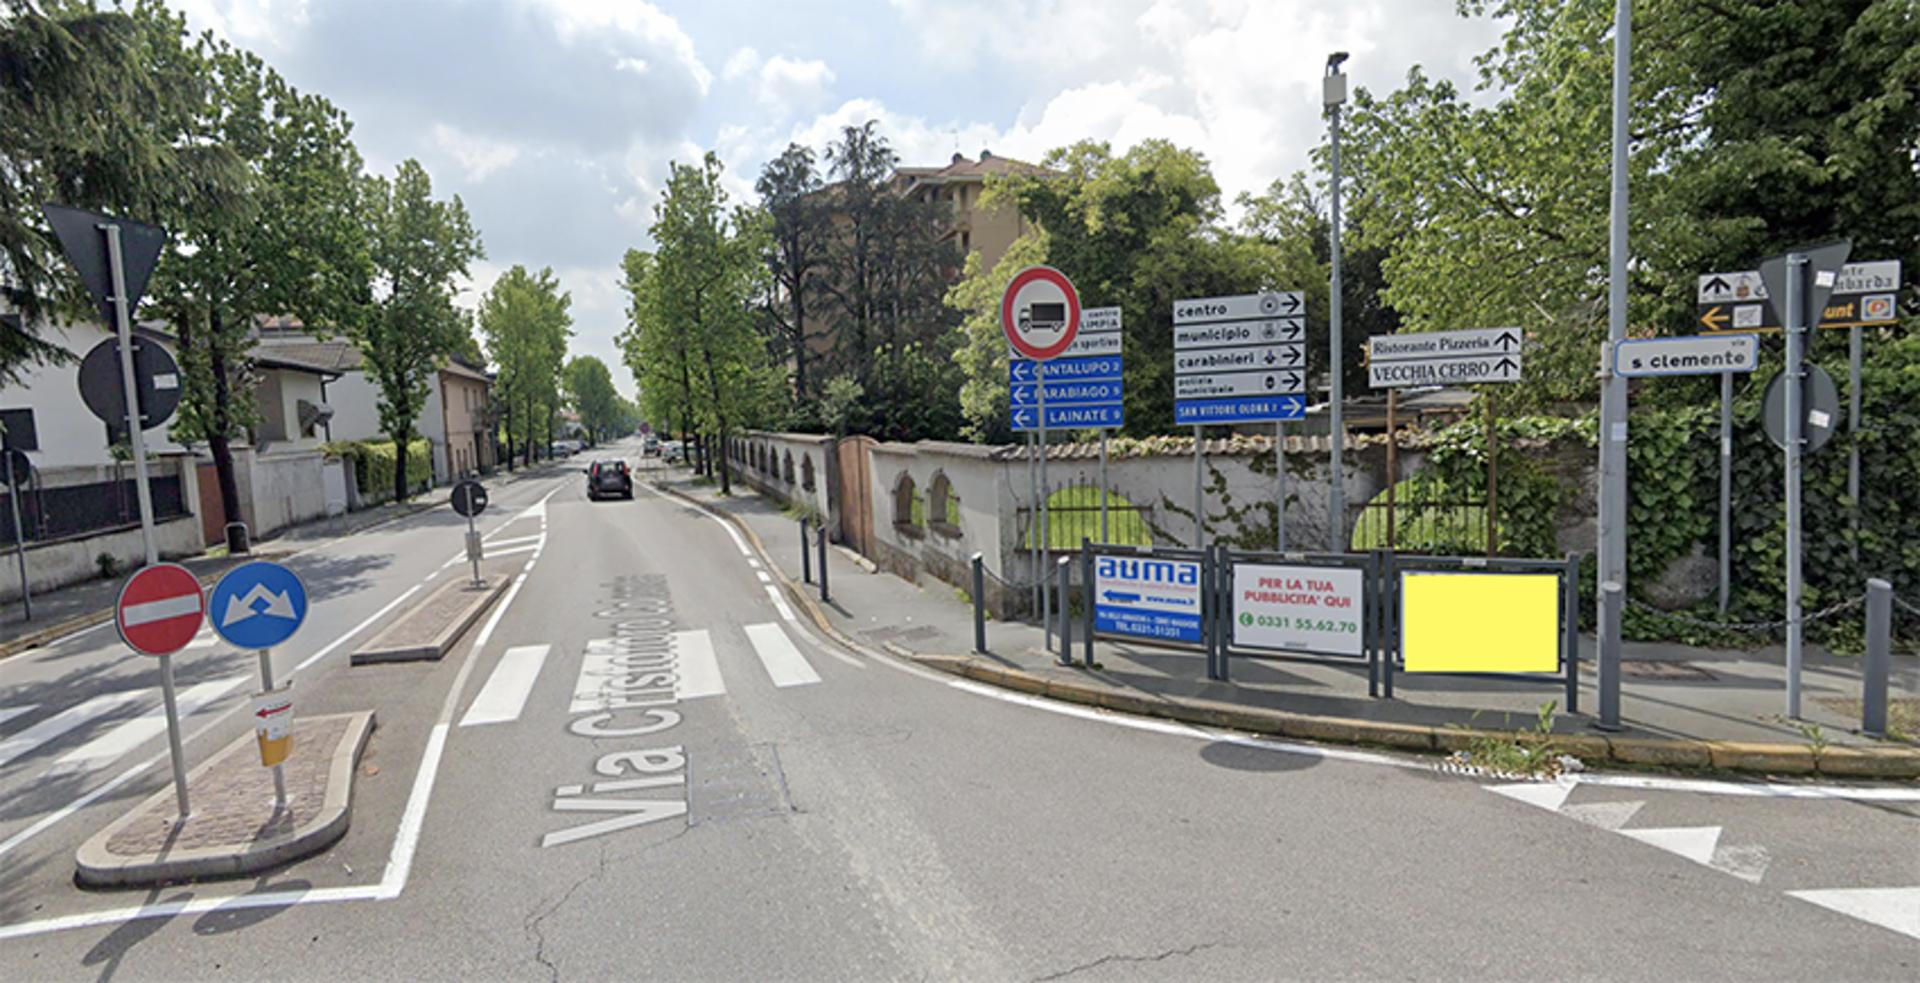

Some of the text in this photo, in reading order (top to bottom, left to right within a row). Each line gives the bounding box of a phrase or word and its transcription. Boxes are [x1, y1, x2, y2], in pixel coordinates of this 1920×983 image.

[1177, 304, 1228, 318] centro
[1178, 326, 1251, 342] municipio
[1372, 336, 1490, 355] Ristorante Pizzeria
[1731, 339, 1746, 347] via
[1178, 352, 1255, 369] carabinieri
[1632, 351, 1746, 369] s clemente
[1373, 360, 1490, 381] VECCHIA CERRO
[1050, 409, 1108, 423] LAINATE
[1179, 404, 1198, 417] SAN
[1200, 402, 1237, 416] VITTORE
[1238, 401, 1270, 414] OLONA
[1099, 558, 1198, 586] auma
[1258, 577, 1334, 592] PER LA TUA
[1244, 590, 1352, 608] PUBBLICITA' QUI
[1257, 615, 1358, 634] 0331 55.62.70
